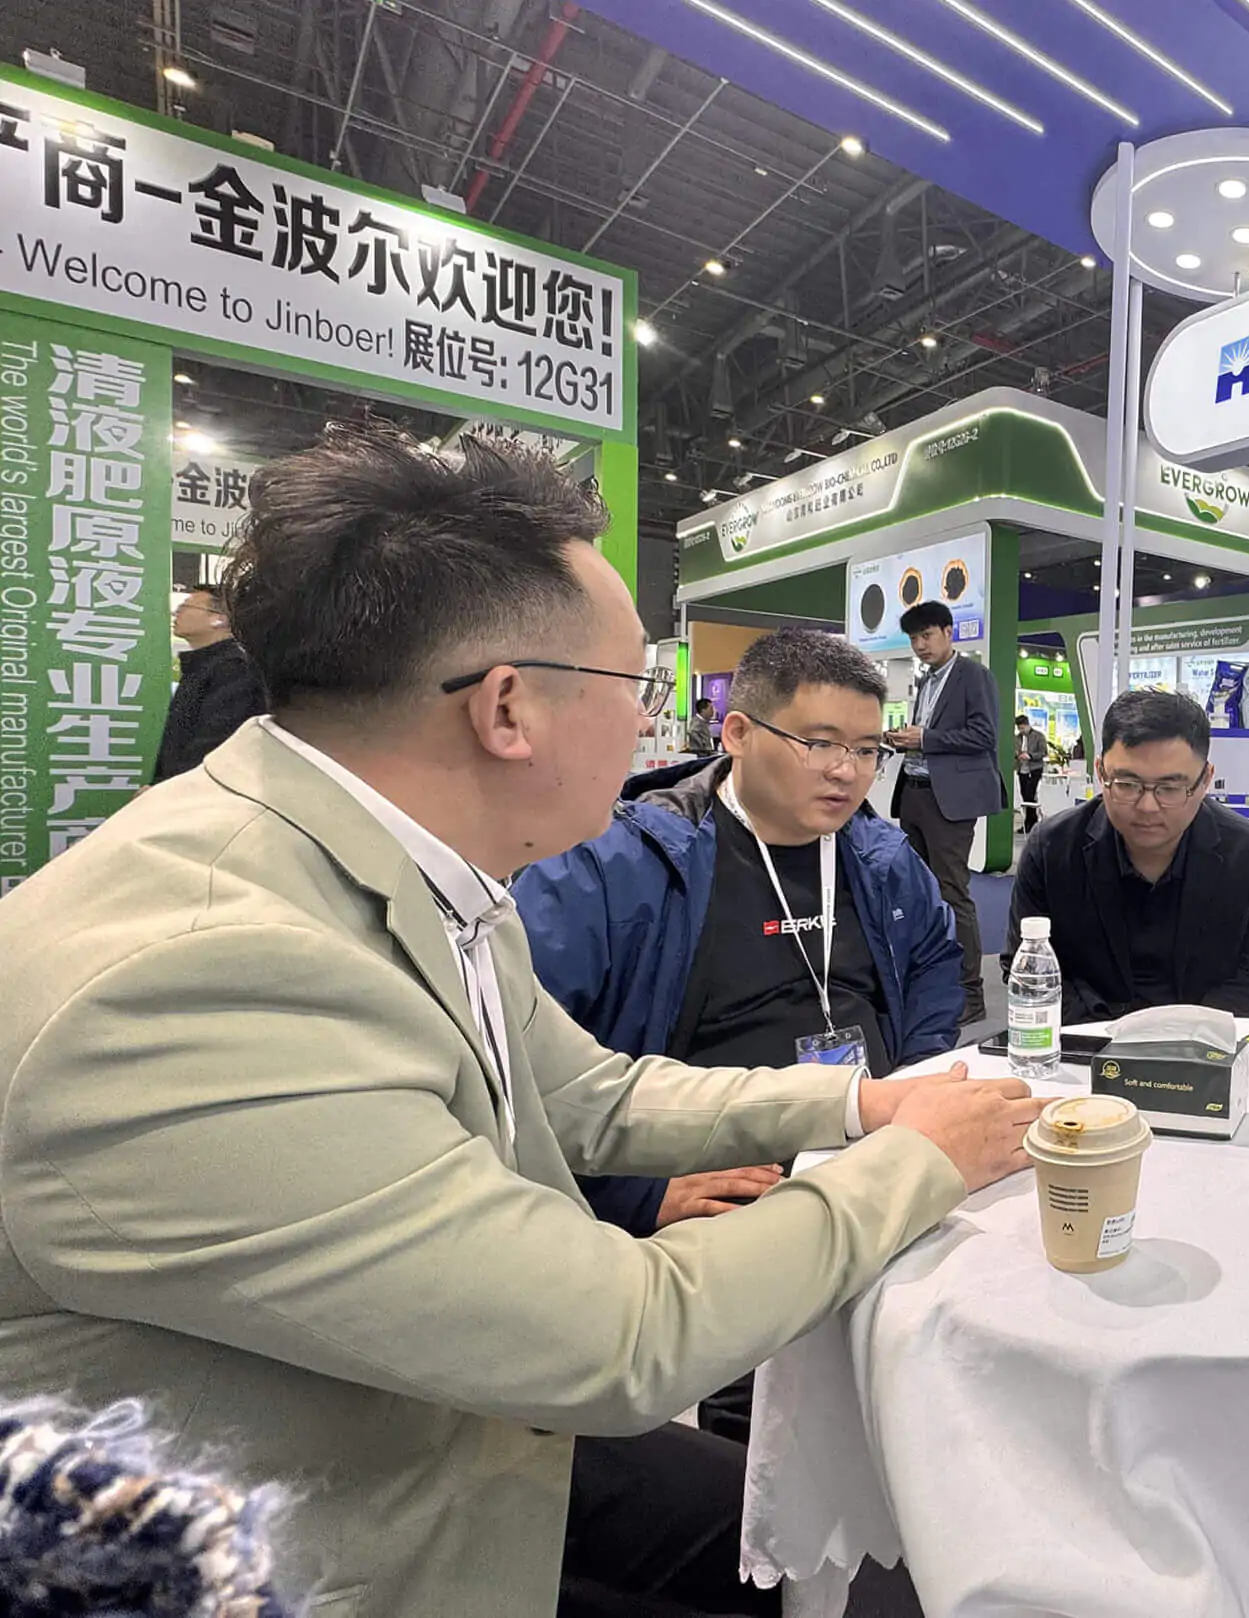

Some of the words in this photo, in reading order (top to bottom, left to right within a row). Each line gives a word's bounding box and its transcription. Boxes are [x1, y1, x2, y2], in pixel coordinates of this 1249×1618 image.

[17, 233, 207, 312] Welcome
[220, 287, 252, 322] to
[266, 299, 394, 357] Jinboer!
[1, 341, 38, 387] The
[1, 396, 38, 484] world's
[0, 491, 37, 579] largest
[202, 519, 216, 535] to
[722, 510, 759, 537] EVERGROW
[0, 586, 37, 684] Original
[46, 342, 146, 859] 清液肥原液专业生产
[0, 692, 37, 867] manufacturer
[1124, 1079, 1138, 1087] Soft
[1154, 1082, 1194, 1092] comfortable
